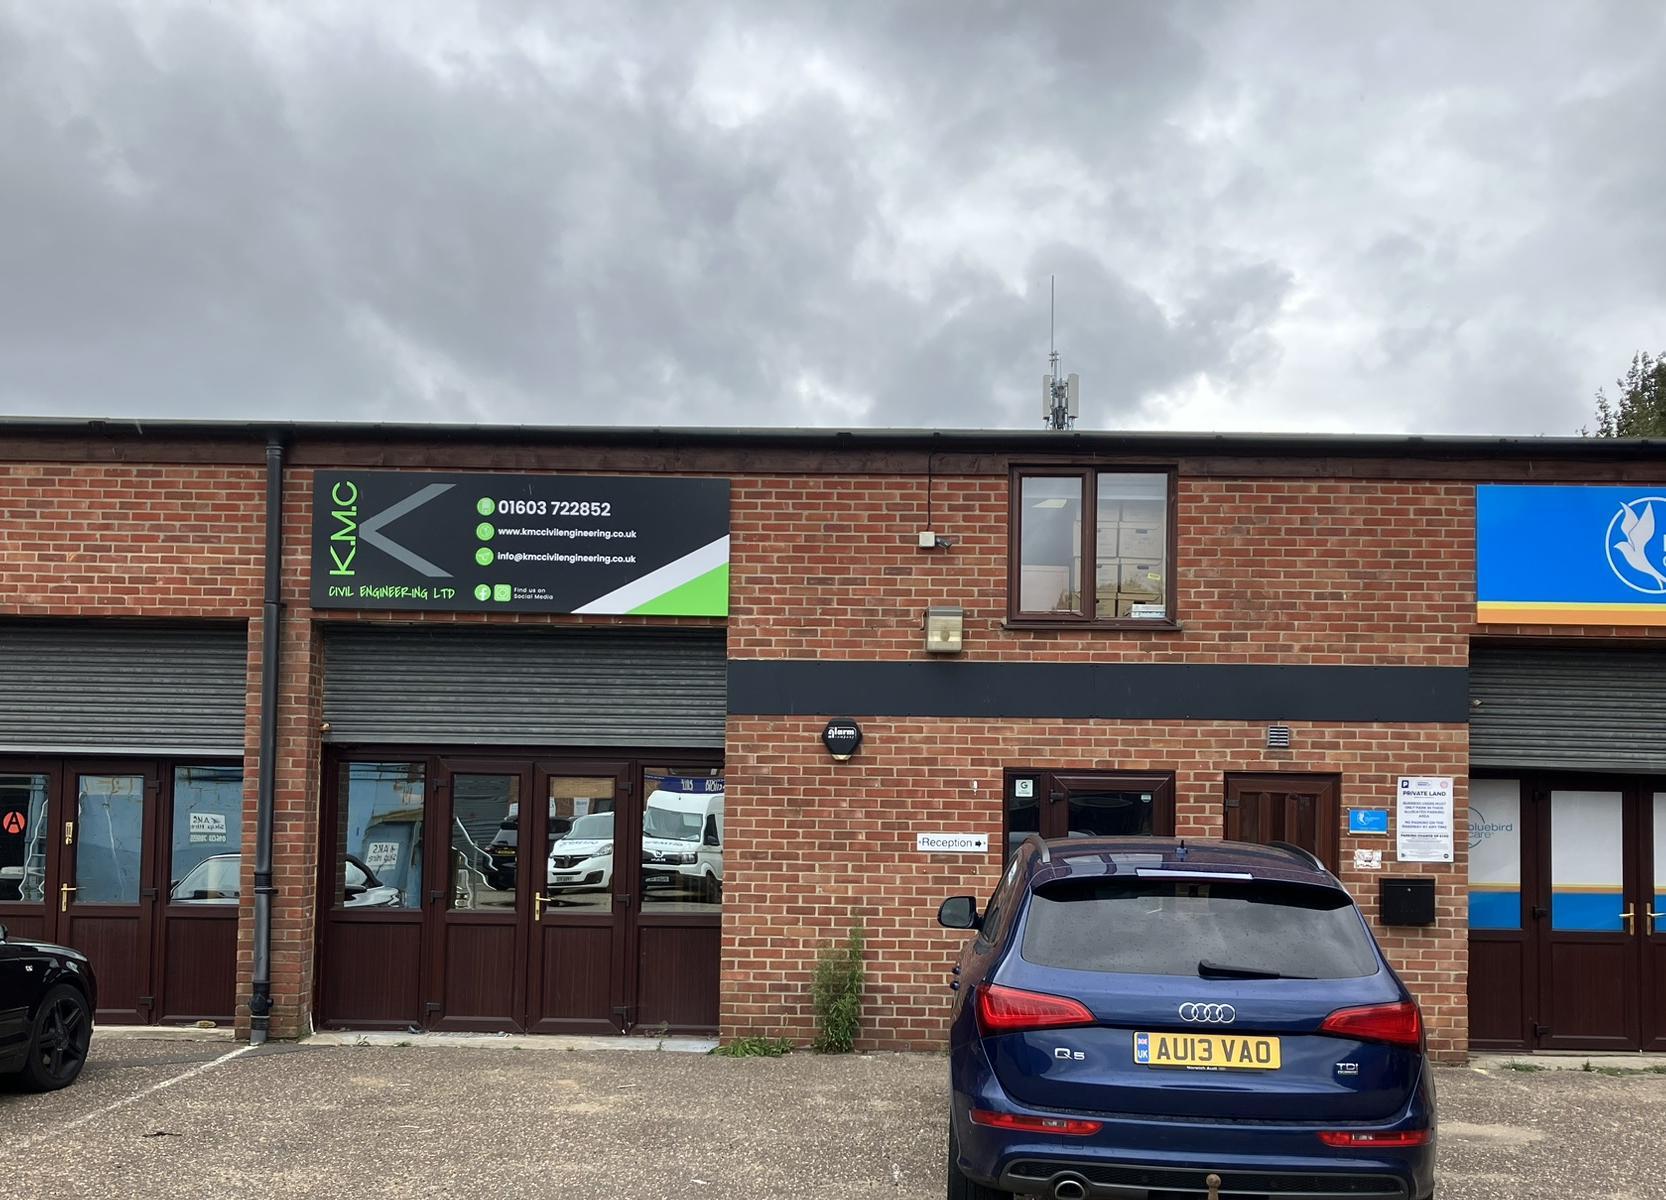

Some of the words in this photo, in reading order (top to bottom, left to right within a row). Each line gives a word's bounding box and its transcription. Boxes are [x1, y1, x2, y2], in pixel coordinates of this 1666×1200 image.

[498, 500, 547, 515] 01603
[551, 501, 611, 517] 722852
[497, 528, 637, 539] www.kmccivilengineering.co.uk
[497, 552, 637, 564] info@kmccivilengineering.co.uk
[329, 585, 354, 597] CIVIL
[360, 585, 428, 600] ENGINEERING
[433, 587, 456, 599] LTD
[1468, 823, 1513, 832] bluebird
[921, 837, 973, 848] Reception
[1054, 1047, 1085, 1061] Q5
[1137, 1049, 1148, 1059] UK
[1156, 1037, 1213, 1062] AU13
[1221, 1039, 1271, 1064] VAO
[1336, 1062, 1359, 1071] TDI
